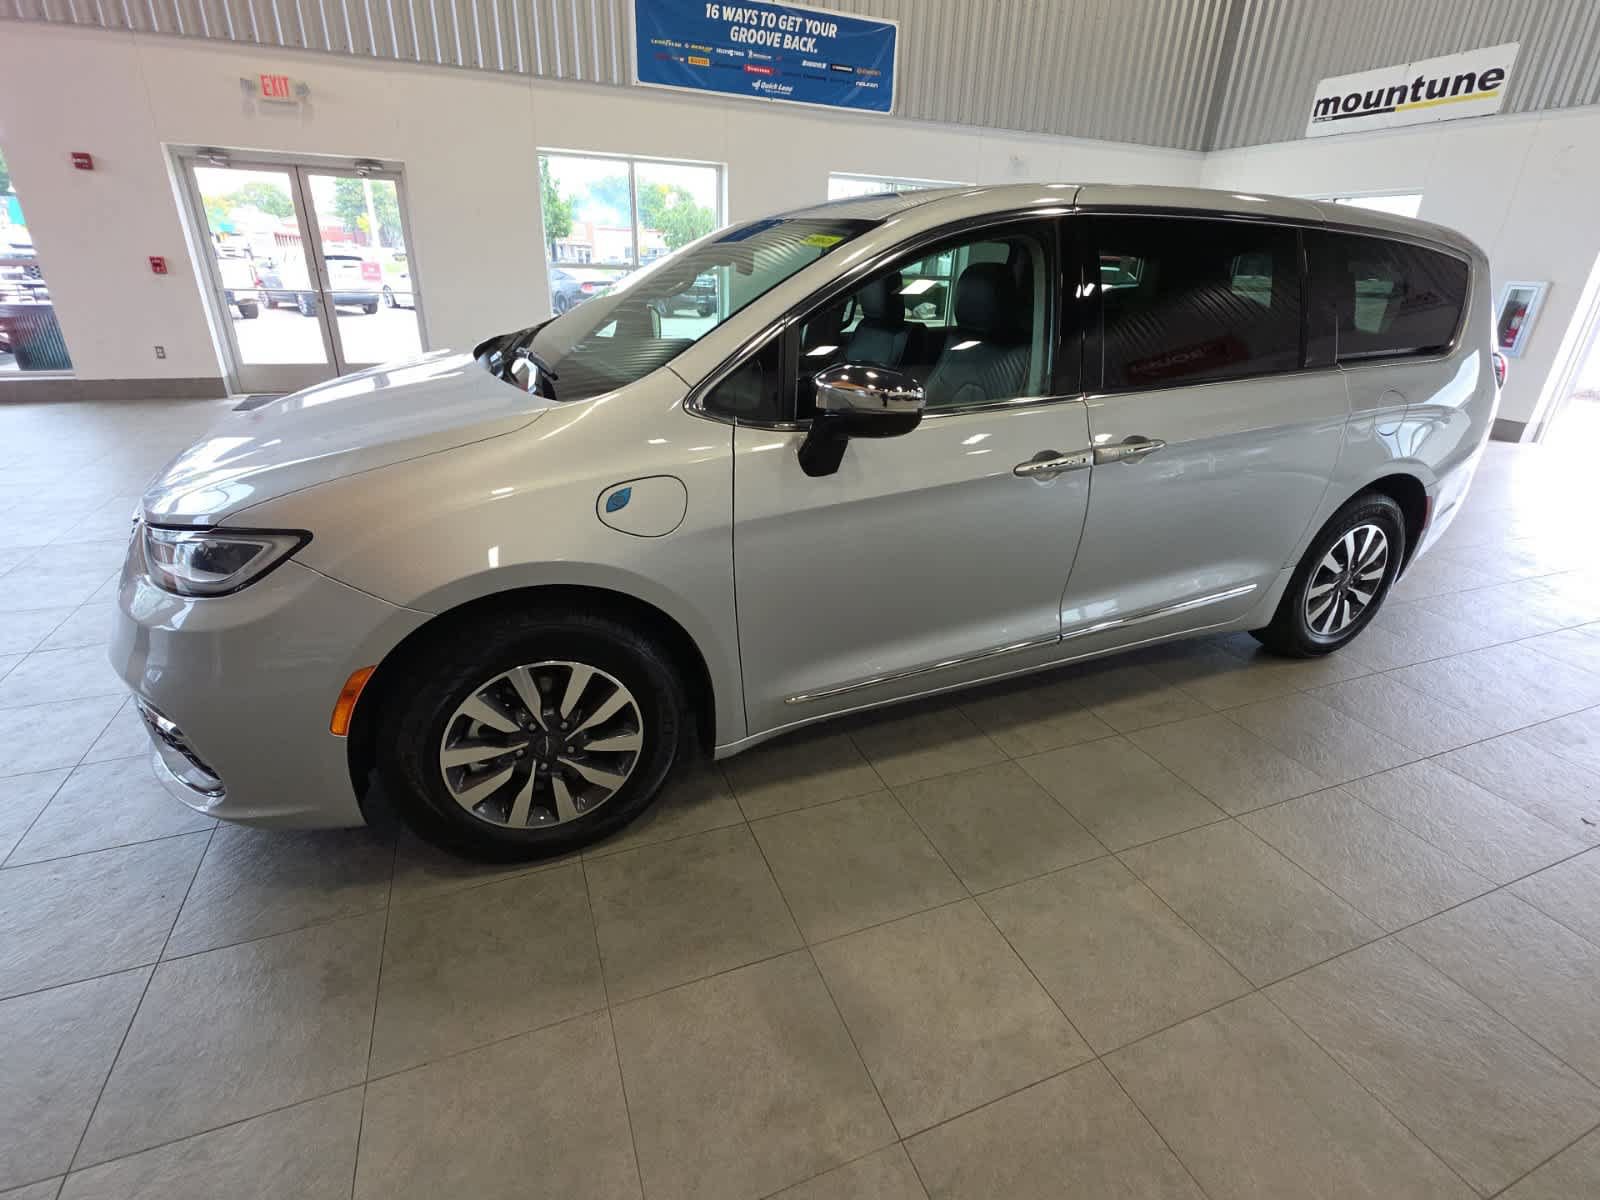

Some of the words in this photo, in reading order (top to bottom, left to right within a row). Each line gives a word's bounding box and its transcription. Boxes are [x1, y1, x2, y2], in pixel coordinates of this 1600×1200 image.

[705, 3, 719, 19] 16
[722, 6, 758, 25] WAYS
[760, 11, 776, 28] TO
[778, 15, 802, 32] GET
[805, 19, 837, 38] YOUR
[730, 25, 781, 48] GROOVE
[783, 33, 818, 53] BACK.
[261, 74, 289, 96] EXIT
[1313, 67, 1505, 117] mountune
